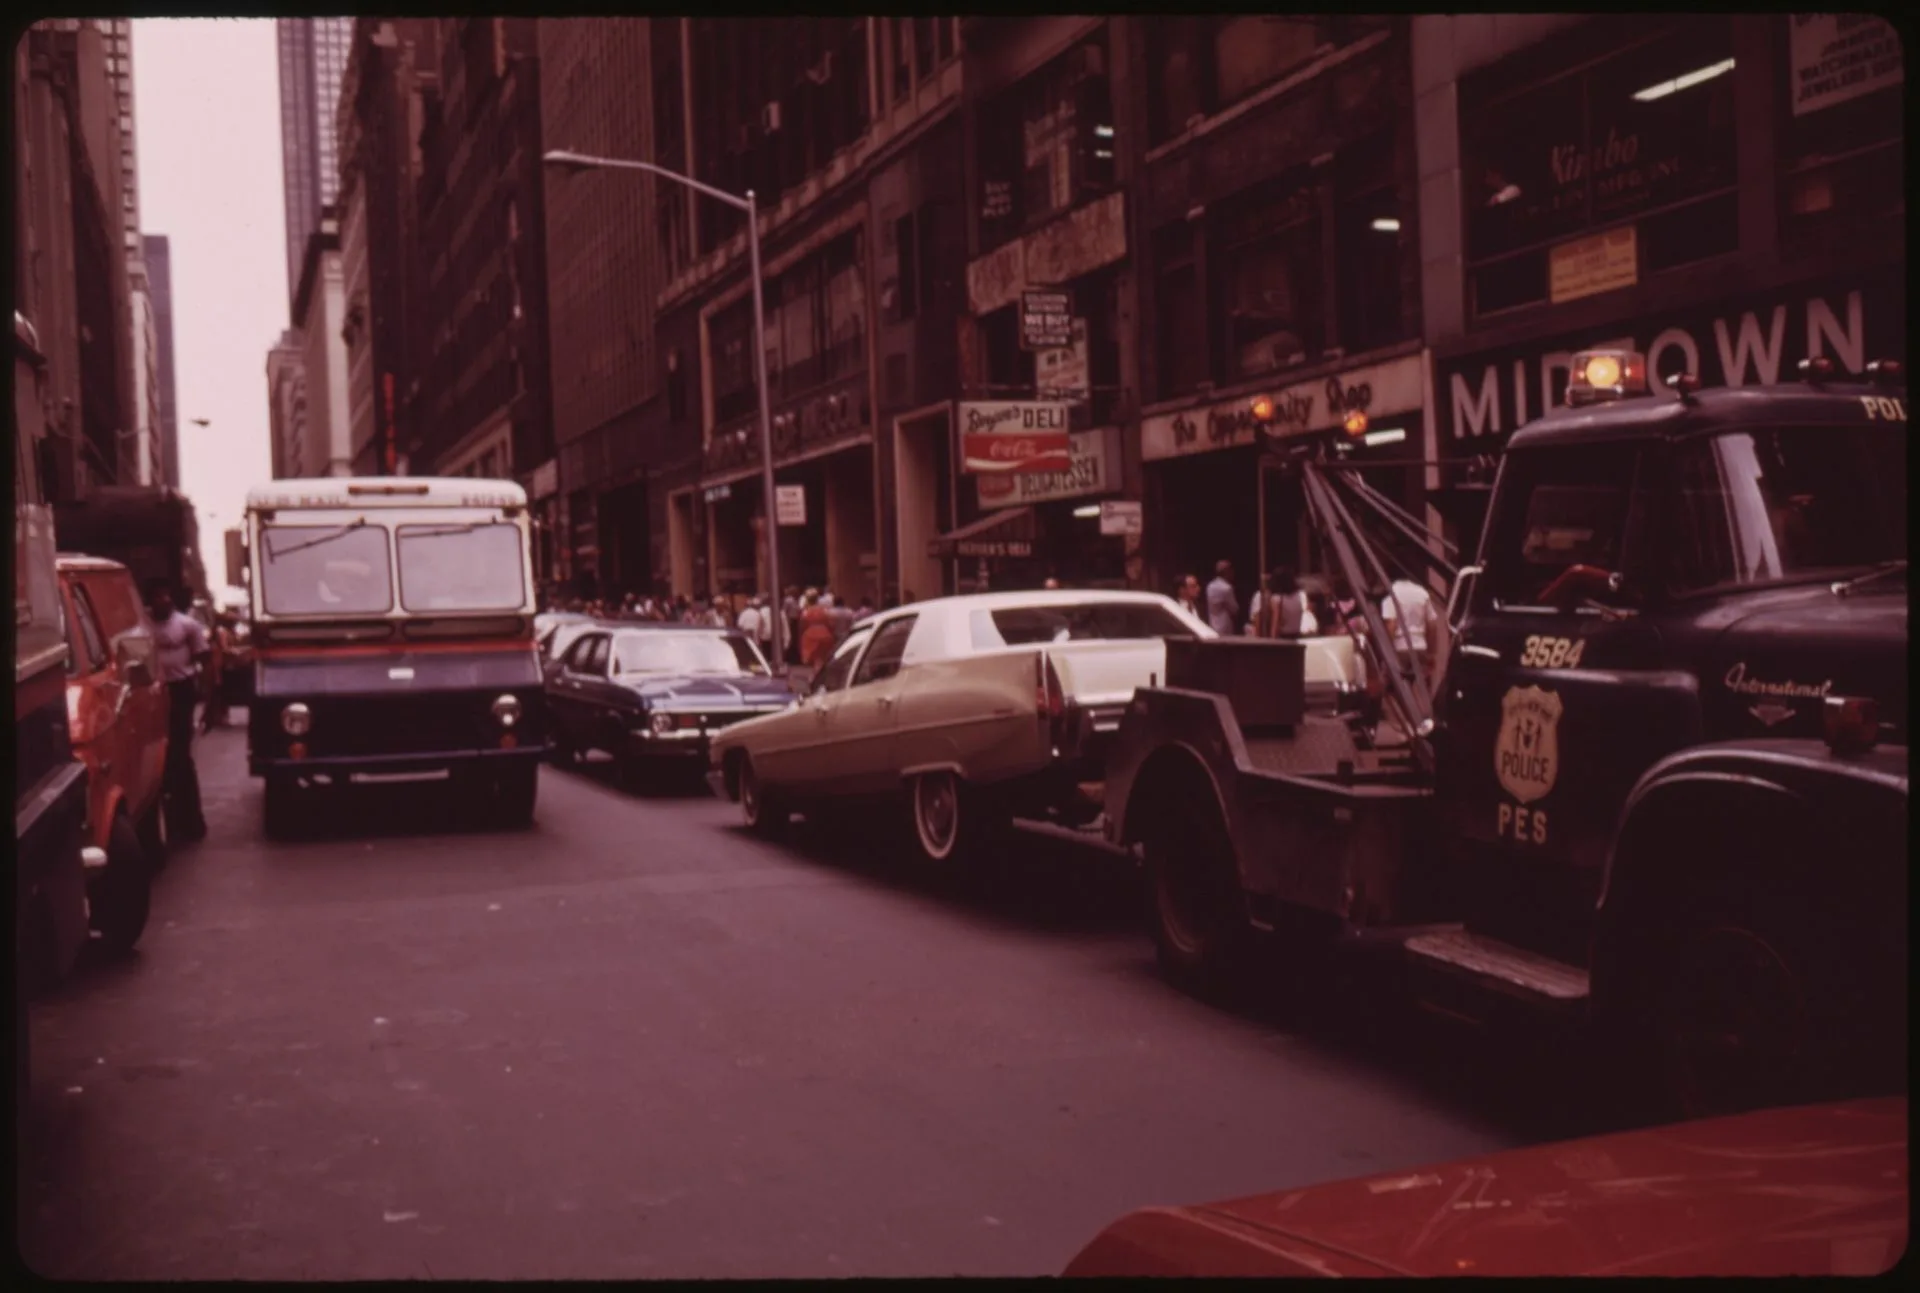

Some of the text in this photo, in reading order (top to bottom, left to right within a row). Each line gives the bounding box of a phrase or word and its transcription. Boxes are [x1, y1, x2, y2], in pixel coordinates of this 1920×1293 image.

[1450, 290, 1865, 440] MIDOWN
[1023, 407, 1065, 429] DELI
[1208, 392, 1314, 443] Oppornity
[1520, 635, 1586, 669] 3584
[1724, 661, 1832, 699] International
[1501, 752, 1550, 784] POLICE
[1498, 802, 1548, 845] PES
